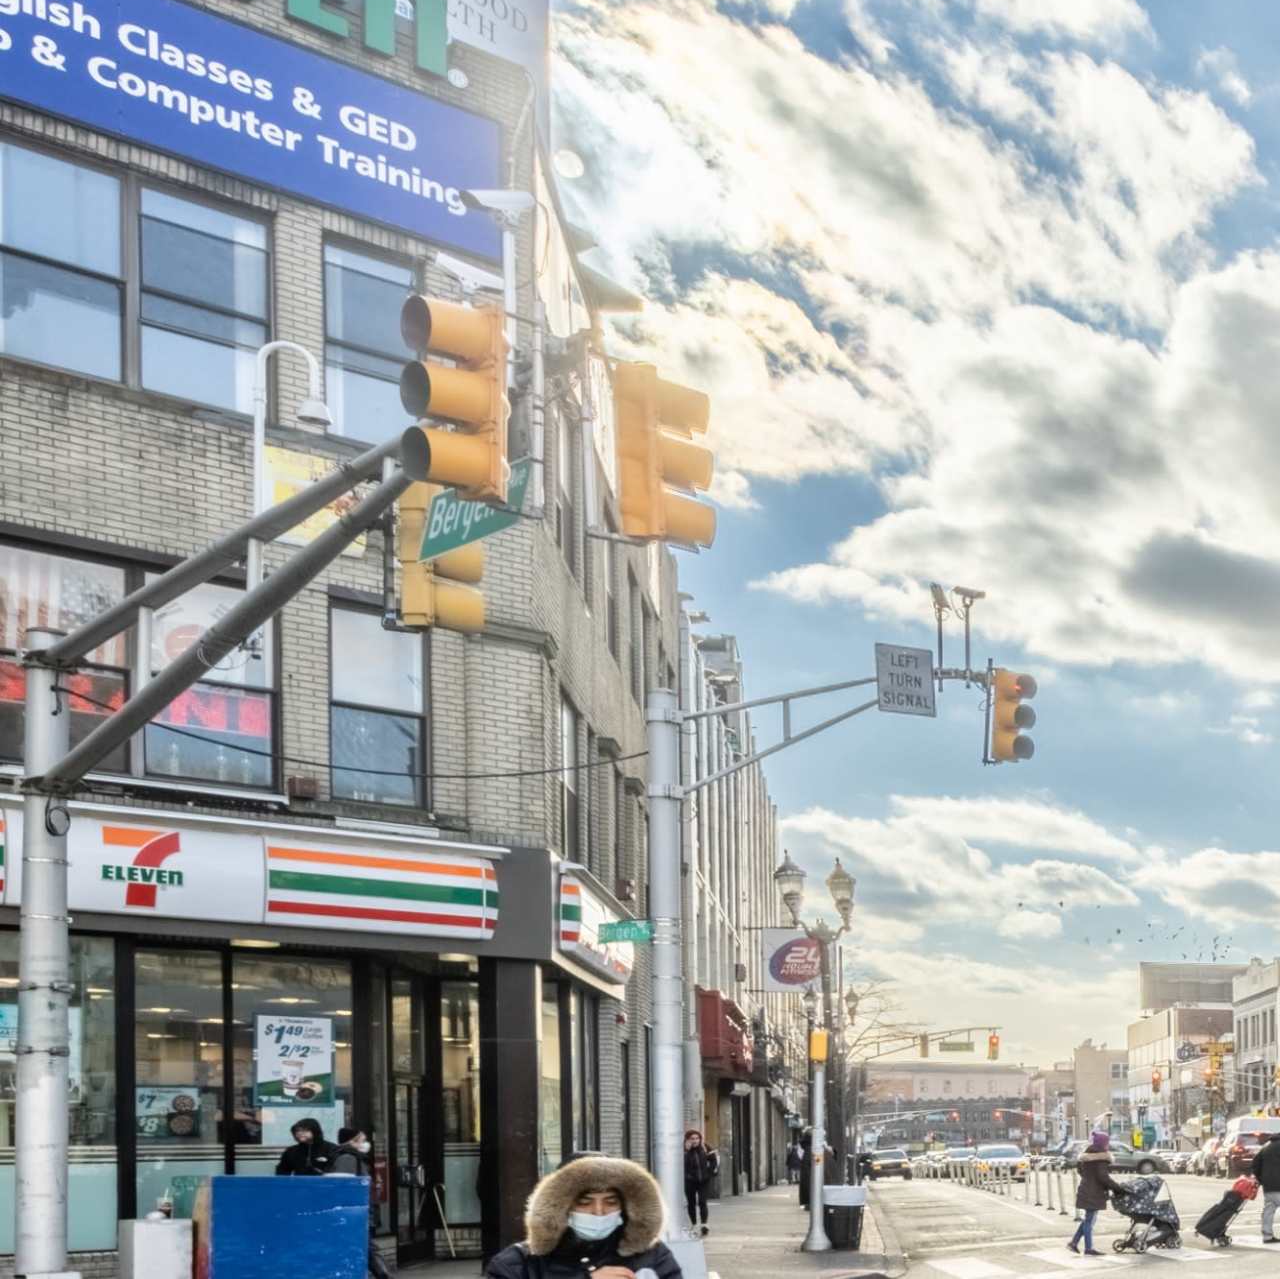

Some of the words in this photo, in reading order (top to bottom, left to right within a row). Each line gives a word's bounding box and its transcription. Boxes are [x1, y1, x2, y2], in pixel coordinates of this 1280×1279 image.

[117, 23, 274, 102] Classes
[292, 86, 323, 120] &
[339, 104, 416, 152] GED
[31, 35, 66, 72] &
[87, 56, 303, 152] Computer
[317, 134, 468, 216] Training
[890, 652, 919, 669] LEFT
[888, 672, 922, 688] TURN
[883, 691, 932, 709] SIGNAL
